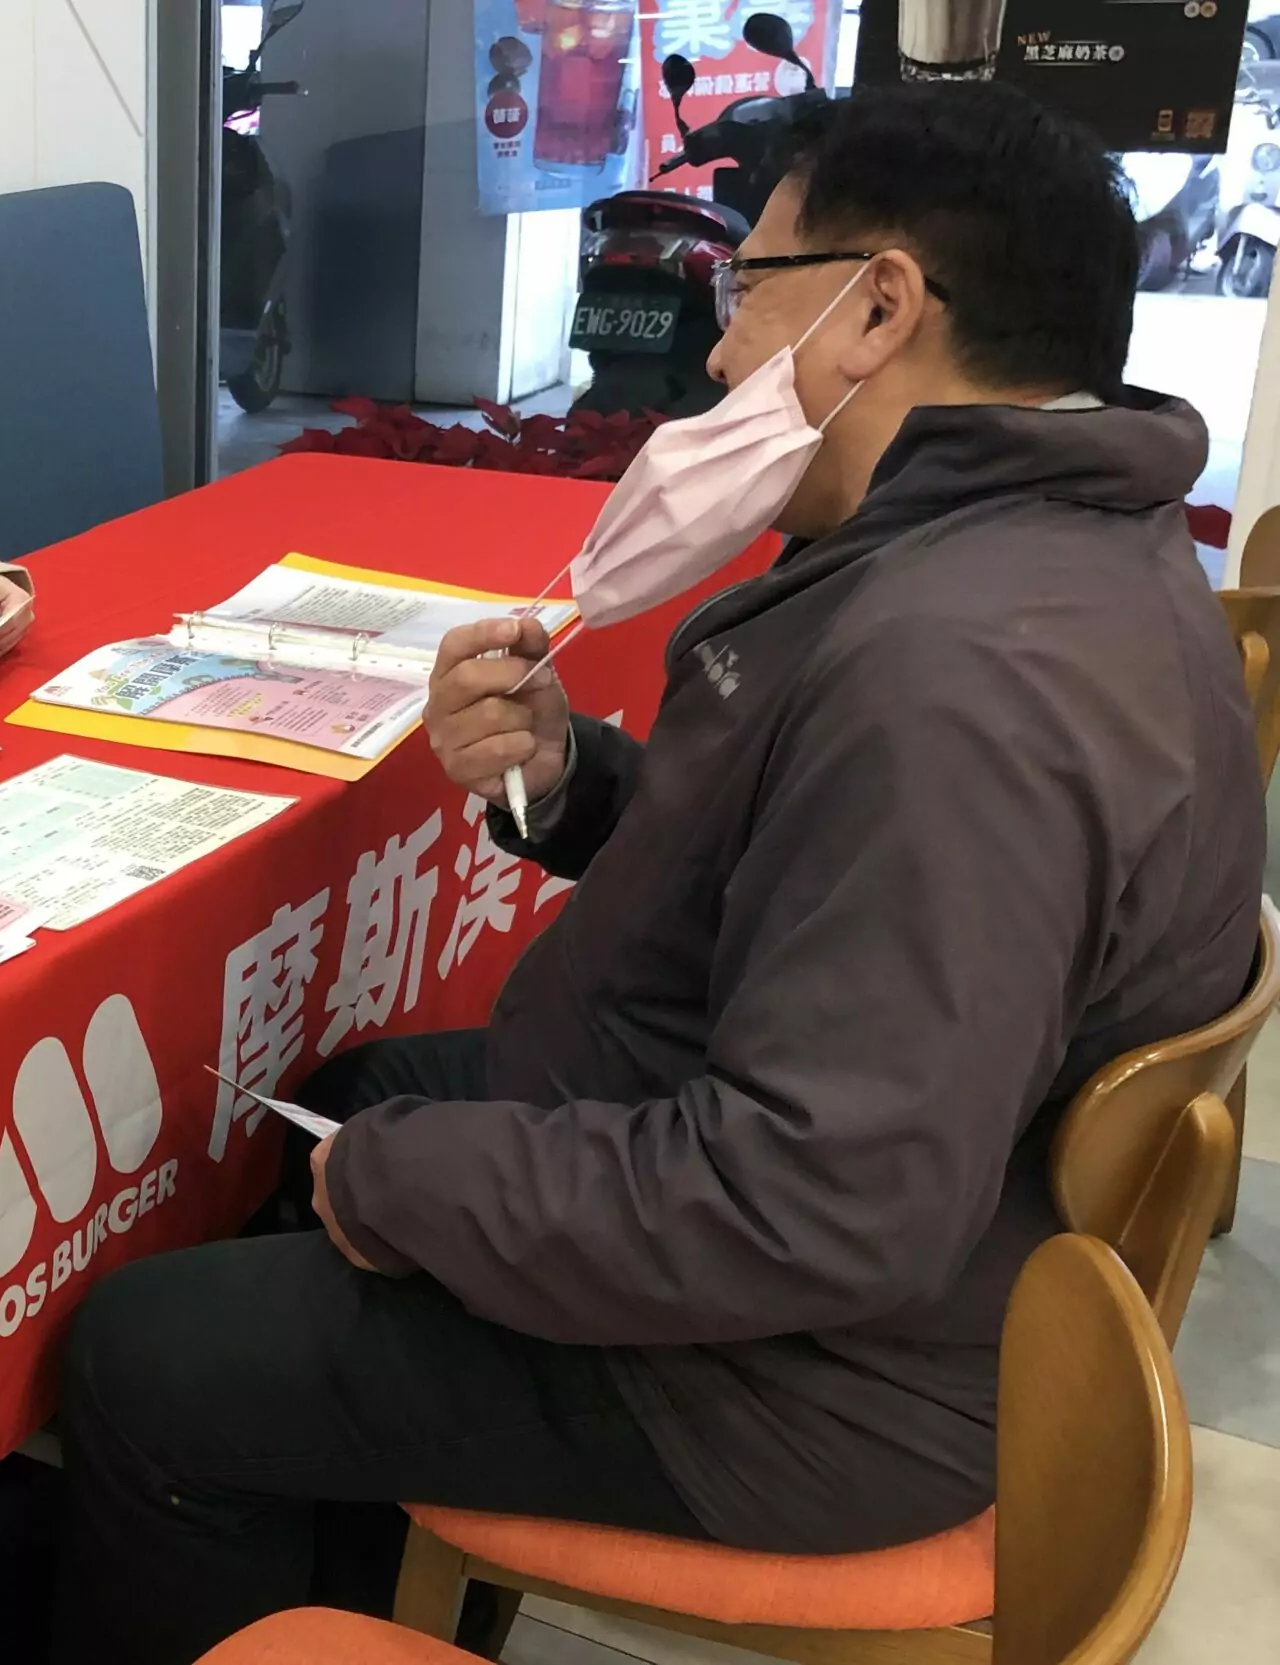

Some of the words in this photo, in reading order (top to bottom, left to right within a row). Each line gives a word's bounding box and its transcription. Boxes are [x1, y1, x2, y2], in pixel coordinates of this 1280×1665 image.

[1017, 30, 1051, 46] NEW
[1024, 44, 1108, 61] 黑芝麻奶茶
[207, 709, 624, 1164] 摩斯漢
[51, 1158, 179, 1293] BURGER
